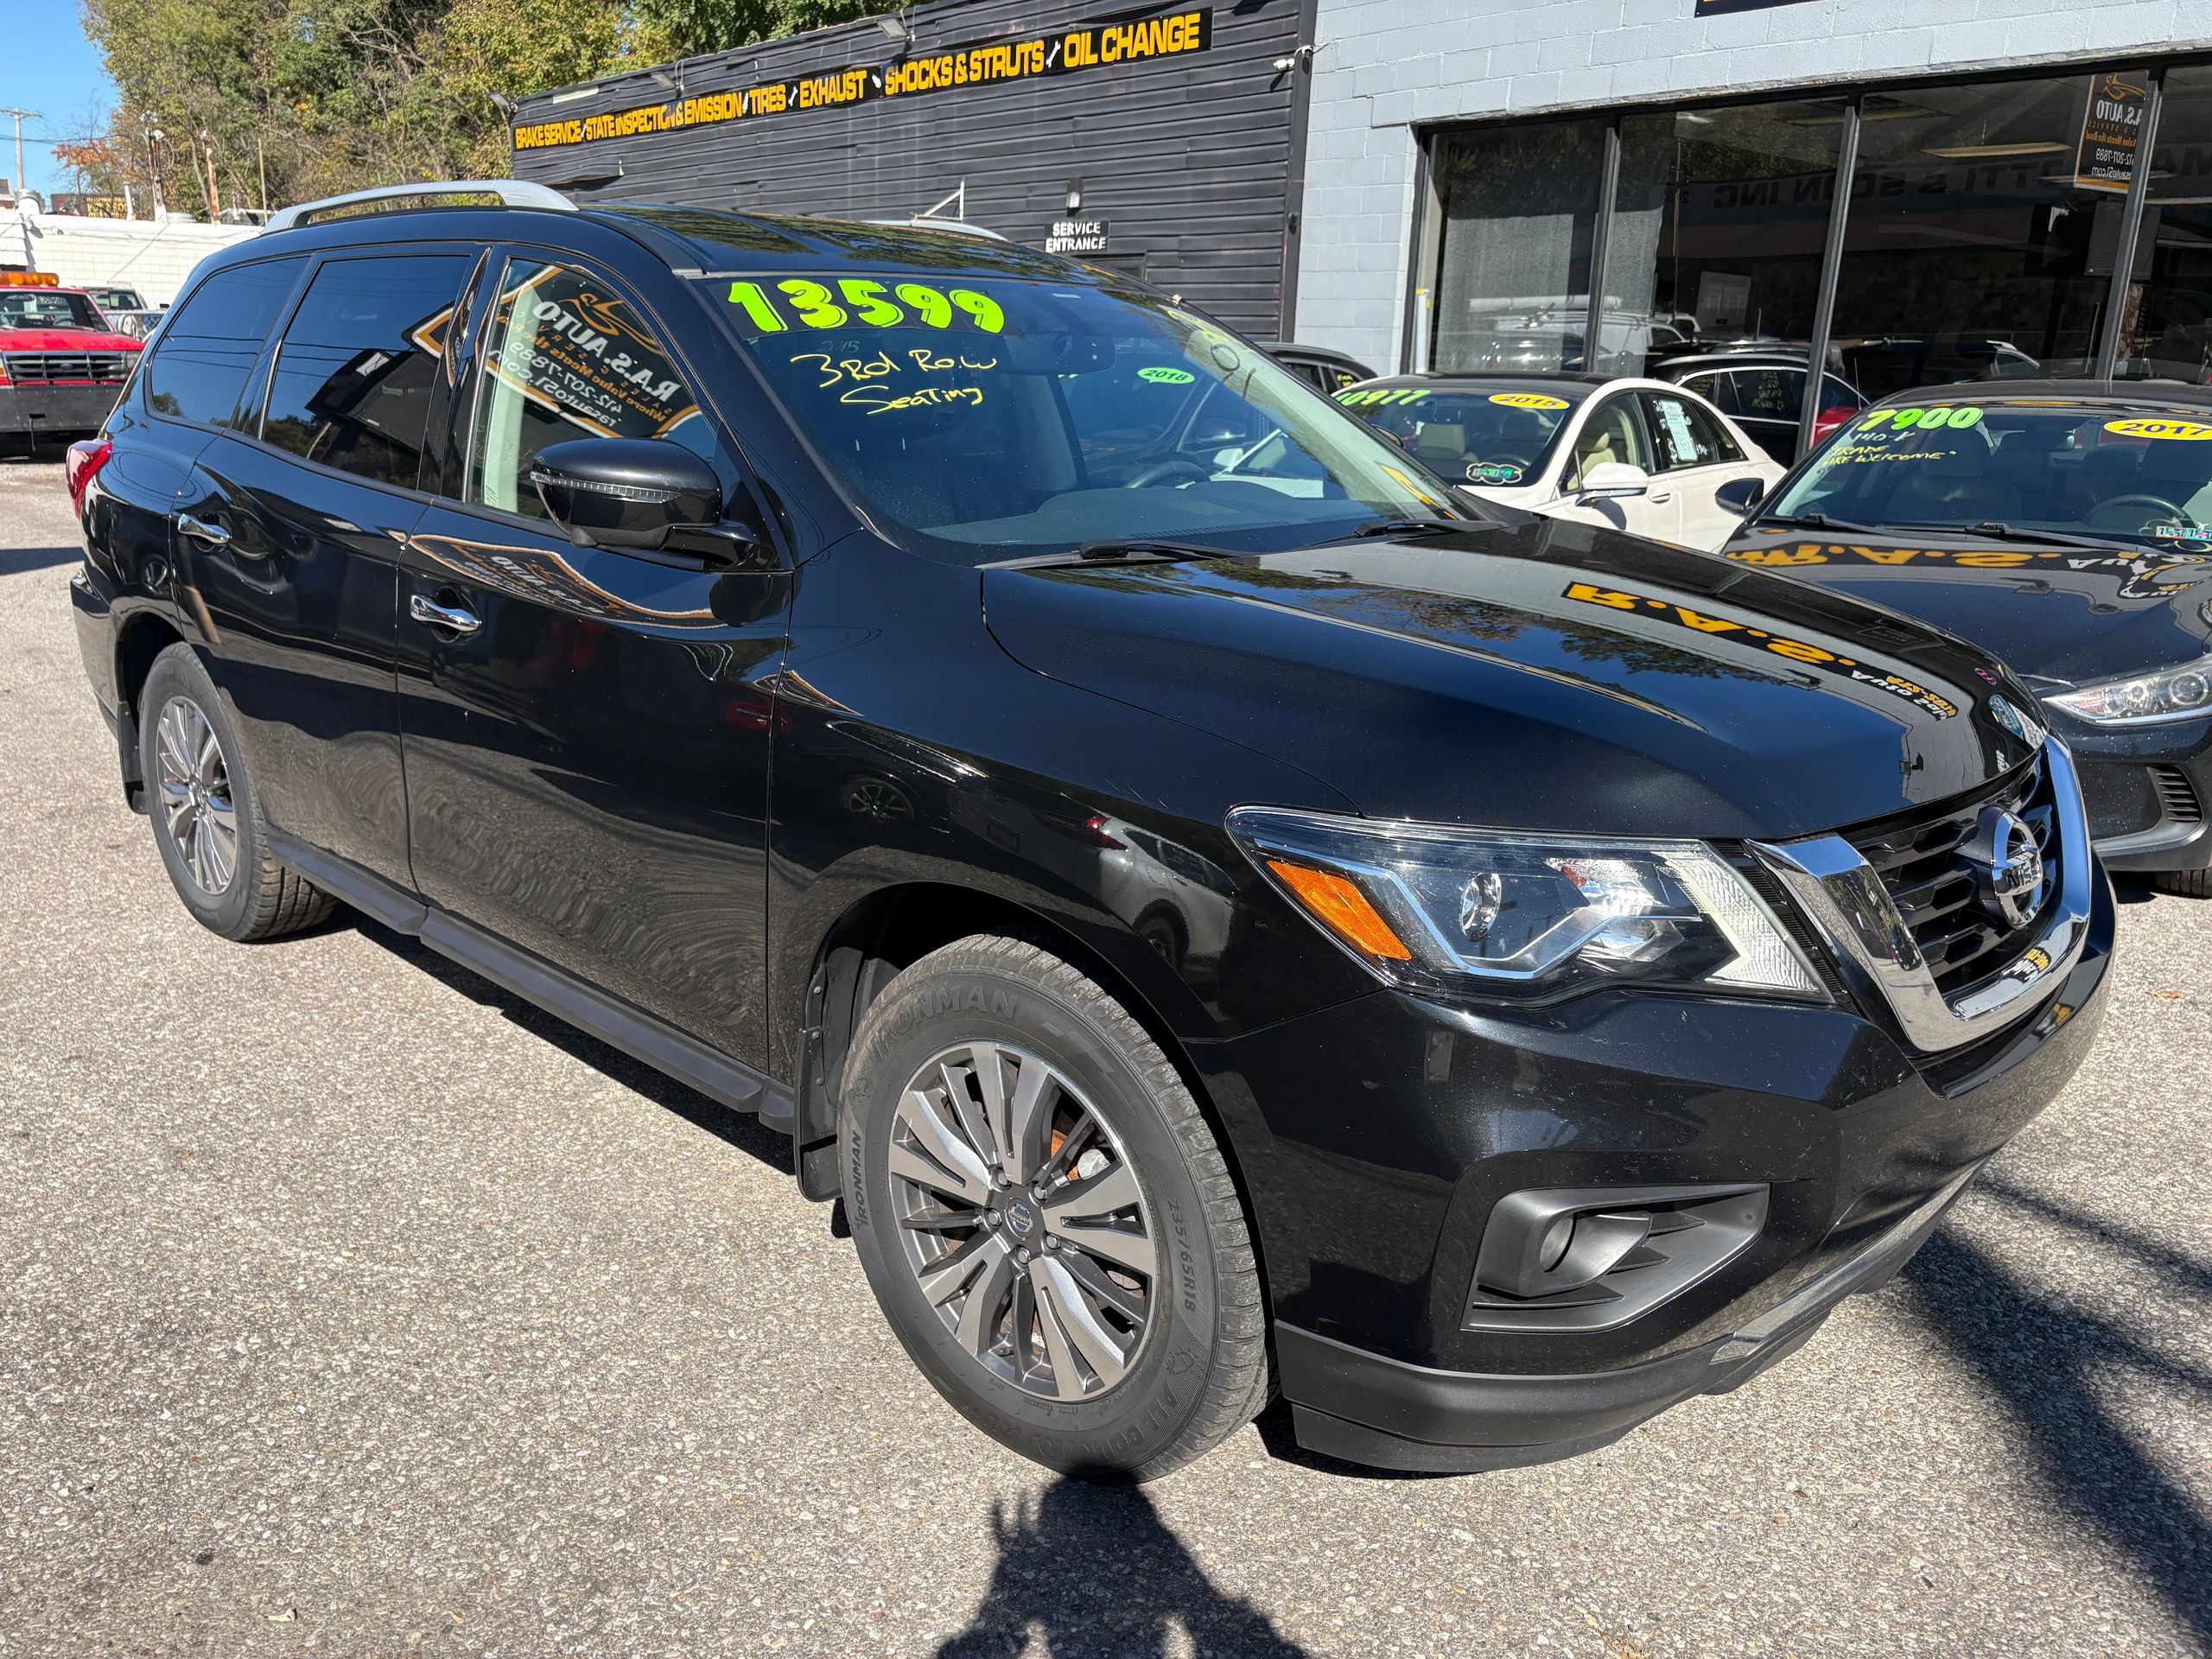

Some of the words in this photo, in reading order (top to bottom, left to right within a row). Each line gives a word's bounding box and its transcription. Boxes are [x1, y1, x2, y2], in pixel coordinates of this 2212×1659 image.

[516, 125, 545, 149] BRAKE
[544, 119, 582, 147] SERVICE
[586, 115, 615, 141] STATE
[615, 106, 676, 137] INSPECTION
[675, 106, 683, 125] &
[684, 92, 743, 125] EMISSION
[749, 84, 787, 116] TIRES
[799, 71, 868, 109] EXHAUST
[885, 56, 954, 96] SHOCKS
[955, 53, 969, 84] &
[969, 40, 1046, 82] STRUTS
[1065, 33, 1098, 67] OIL
[1102, 13, 1201, 61] CHANGE
[1052, 221, 1102, 238] SERVICE
[1046, 237, 1108, 252] ENTRANCE
[728, 279, 1005, 334] 13599
[1147, 369, 1189, 382] 2018
[1858, 407, 1985, 431] 7900
[2118, 423, 2211, 435] 2017
[852, 1130, 870, 1227] IRONMAN
[1167, 1198, 1198, 1314] 235/65R18
